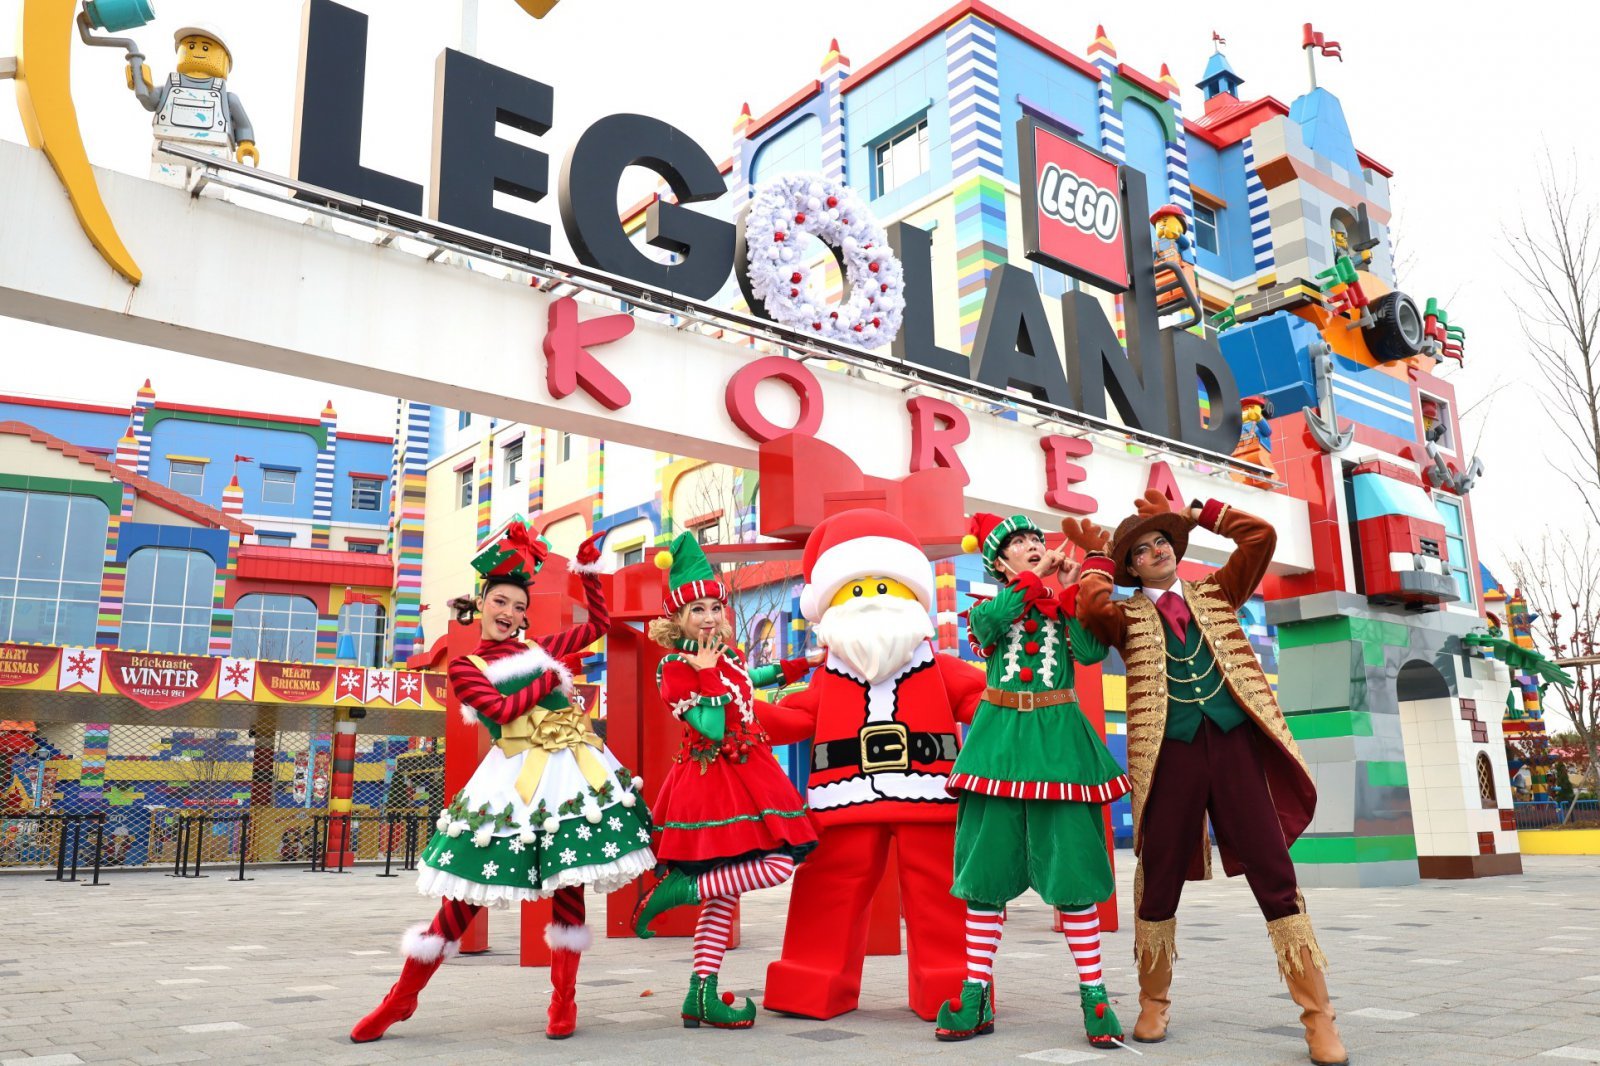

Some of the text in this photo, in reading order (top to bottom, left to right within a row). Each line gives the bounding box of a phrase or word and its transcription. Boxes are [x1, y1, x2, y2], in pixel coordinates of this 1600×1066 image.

[1039, 164, 1118, 240] LEGO
[543, 296, 1186, 515] KOREA
[131, 656, 193, 670] Bricktastic
[121, 667, 199, 688] WINTER
[271, 676, 321, 691] BRICKSMAS
